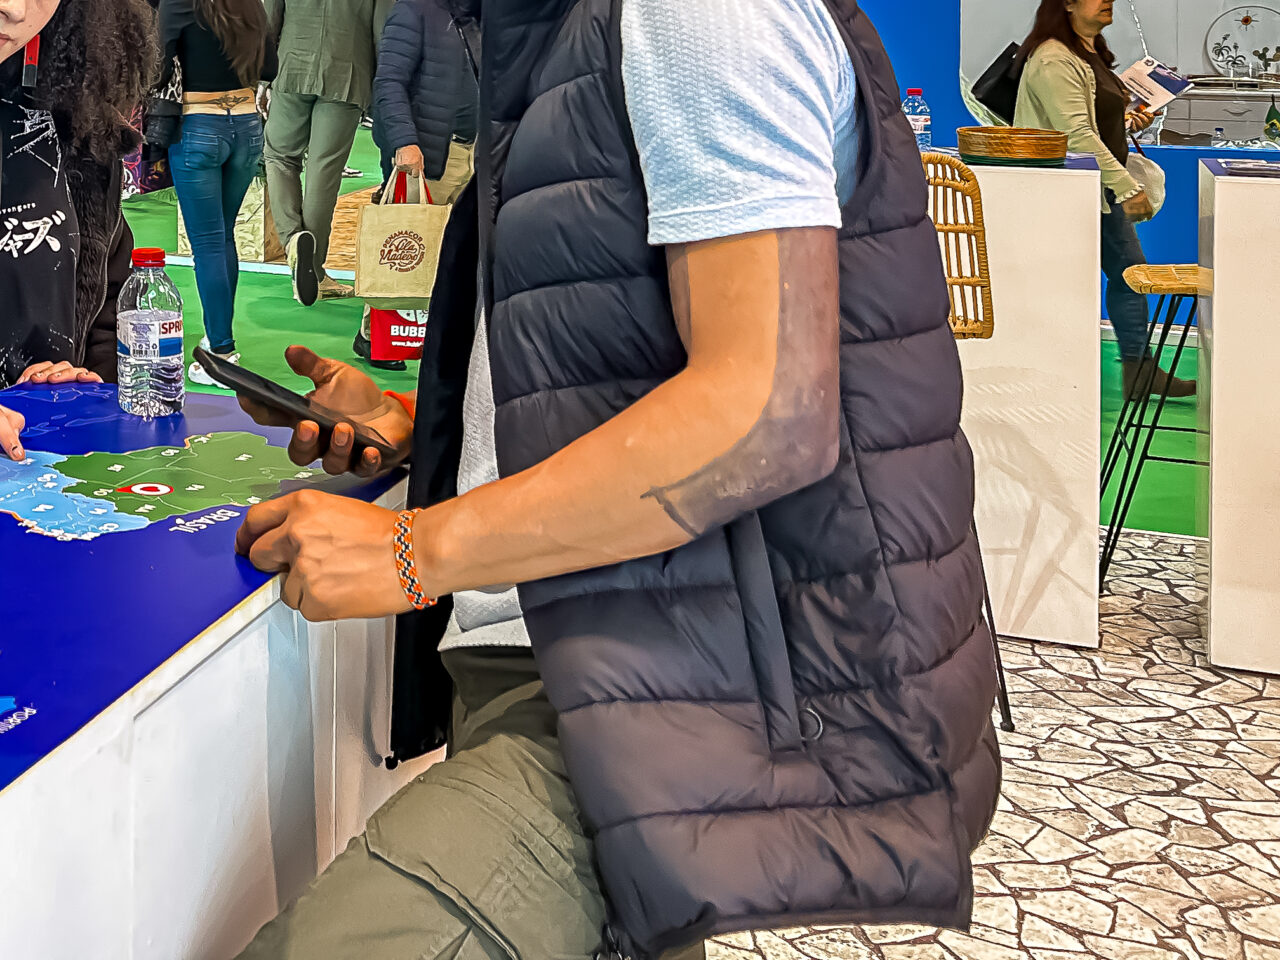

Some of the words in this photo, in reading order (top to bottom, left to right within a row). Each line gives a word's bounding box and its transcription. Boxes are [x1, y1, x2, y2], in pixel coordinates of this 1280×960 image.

[382, 230, 424, 248] PENAMACOR
[390, 324, 427, 338] BUBB
[168, 508, 241, 535] BRASIL
